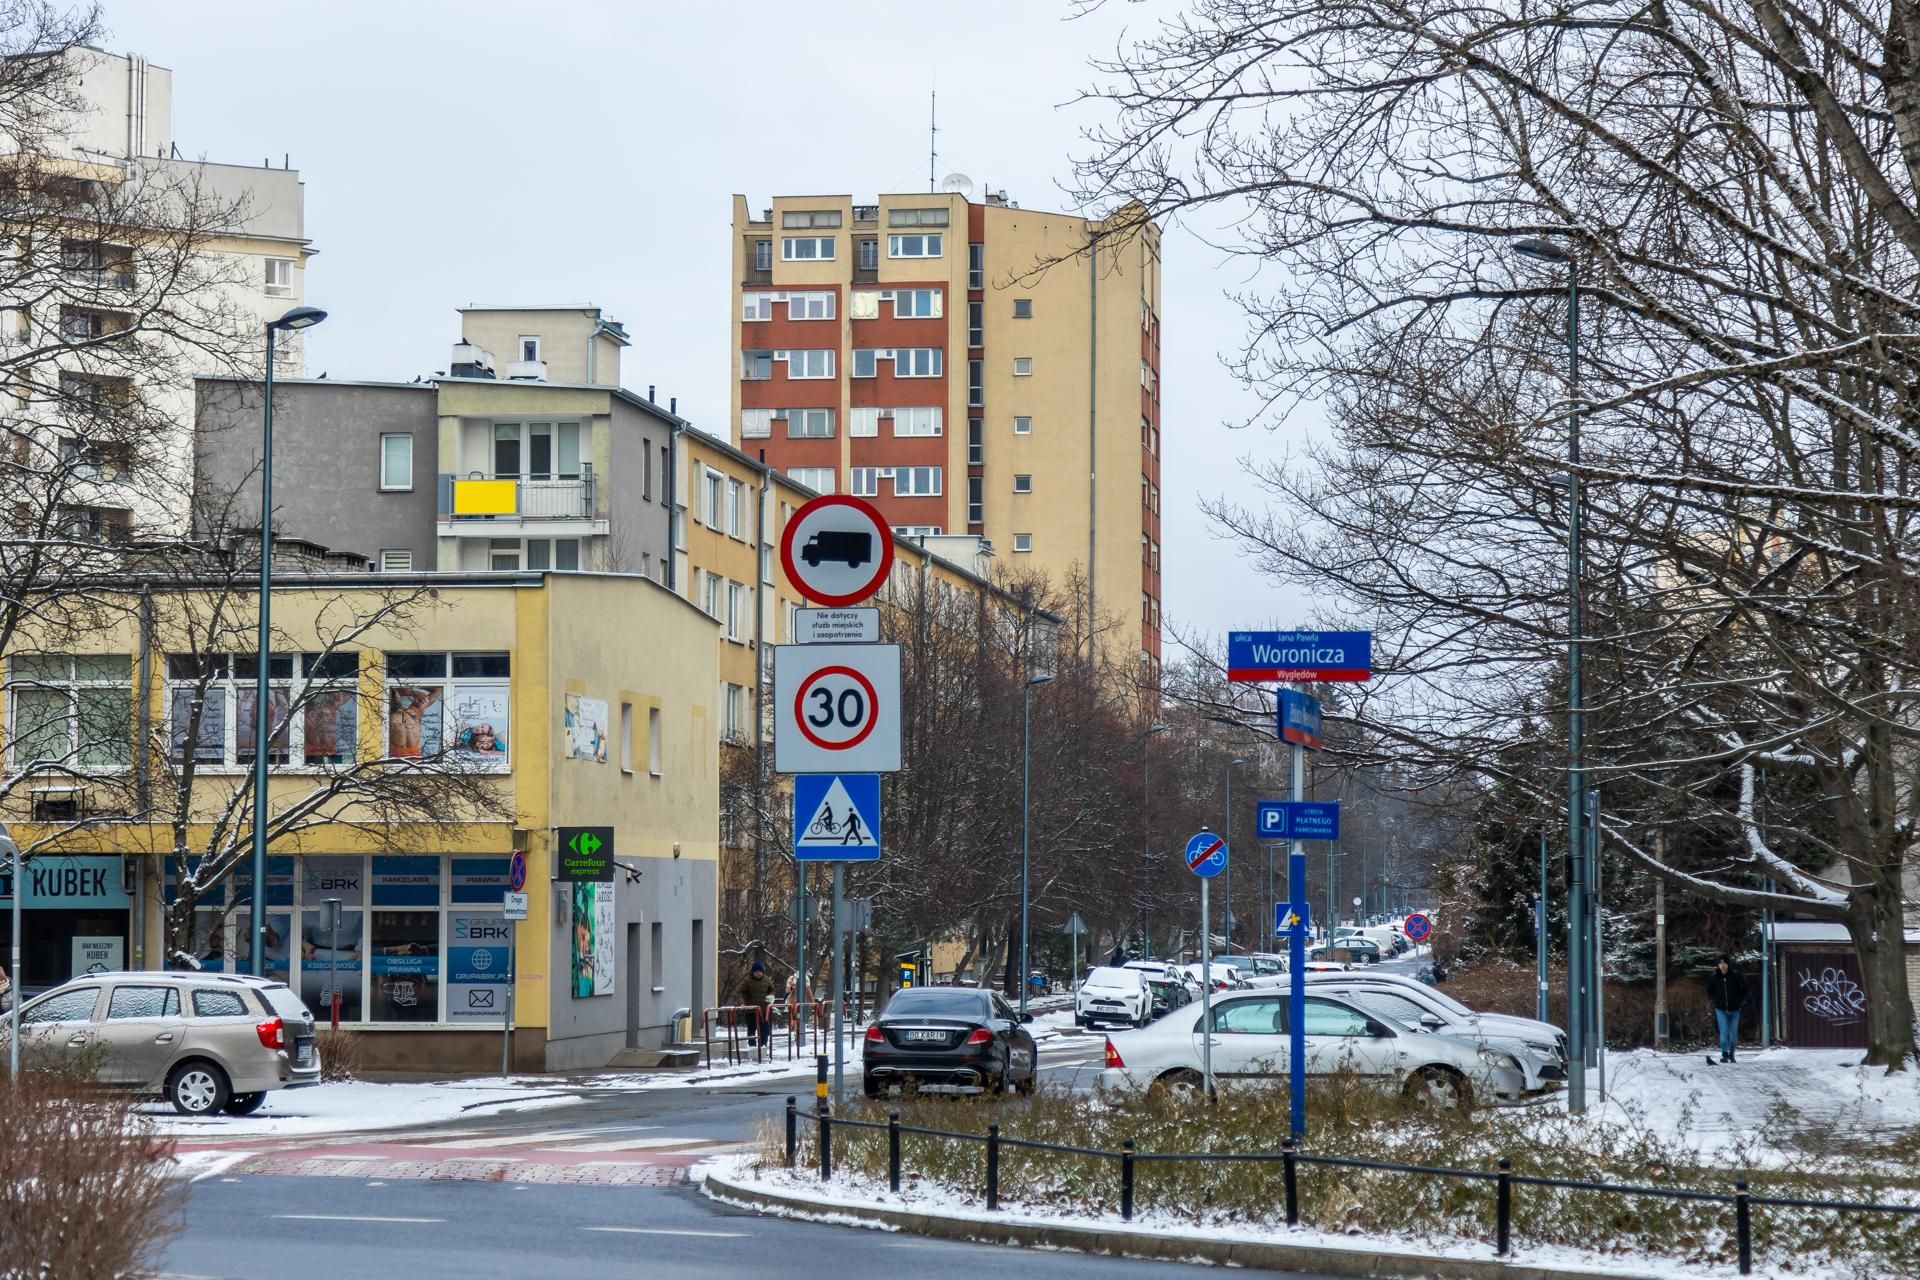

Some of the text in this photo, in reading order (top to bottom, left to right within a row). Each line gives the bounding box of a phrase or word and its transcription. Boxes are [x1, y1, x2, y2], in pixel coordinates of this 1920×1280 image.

[830, 612, 858, 621] dotyczy
[811, 621, 864, 631] służb miejskich
[816, 631, 863, 639] zaopatrzenia
[1235, 633, 1319, 642] ulica Jana Pawła
[1252, 644, 1345, 664] Woronicza
[1277, 669, 1318, 680] Wyględów
[808, 687, 864, 728] 30
[1266, 811, 1280, 829] P
[564, 859, 607, 867] Carrefour
[321, 869, 359, 878] GRUPA
[570, 868, 600, 876] express
[32, 868, 107, 897] KUBEK
[321, 878, 359, 890] BRK
[382, 876, 430, 884] KANCELARIA
[470, 918, 508, 926] GRUPA
[470, 927, 509, 939] BRK
[86, 951, 109, 960] KUBEK
[386, 957, 423, 965] OBSŁUGA
